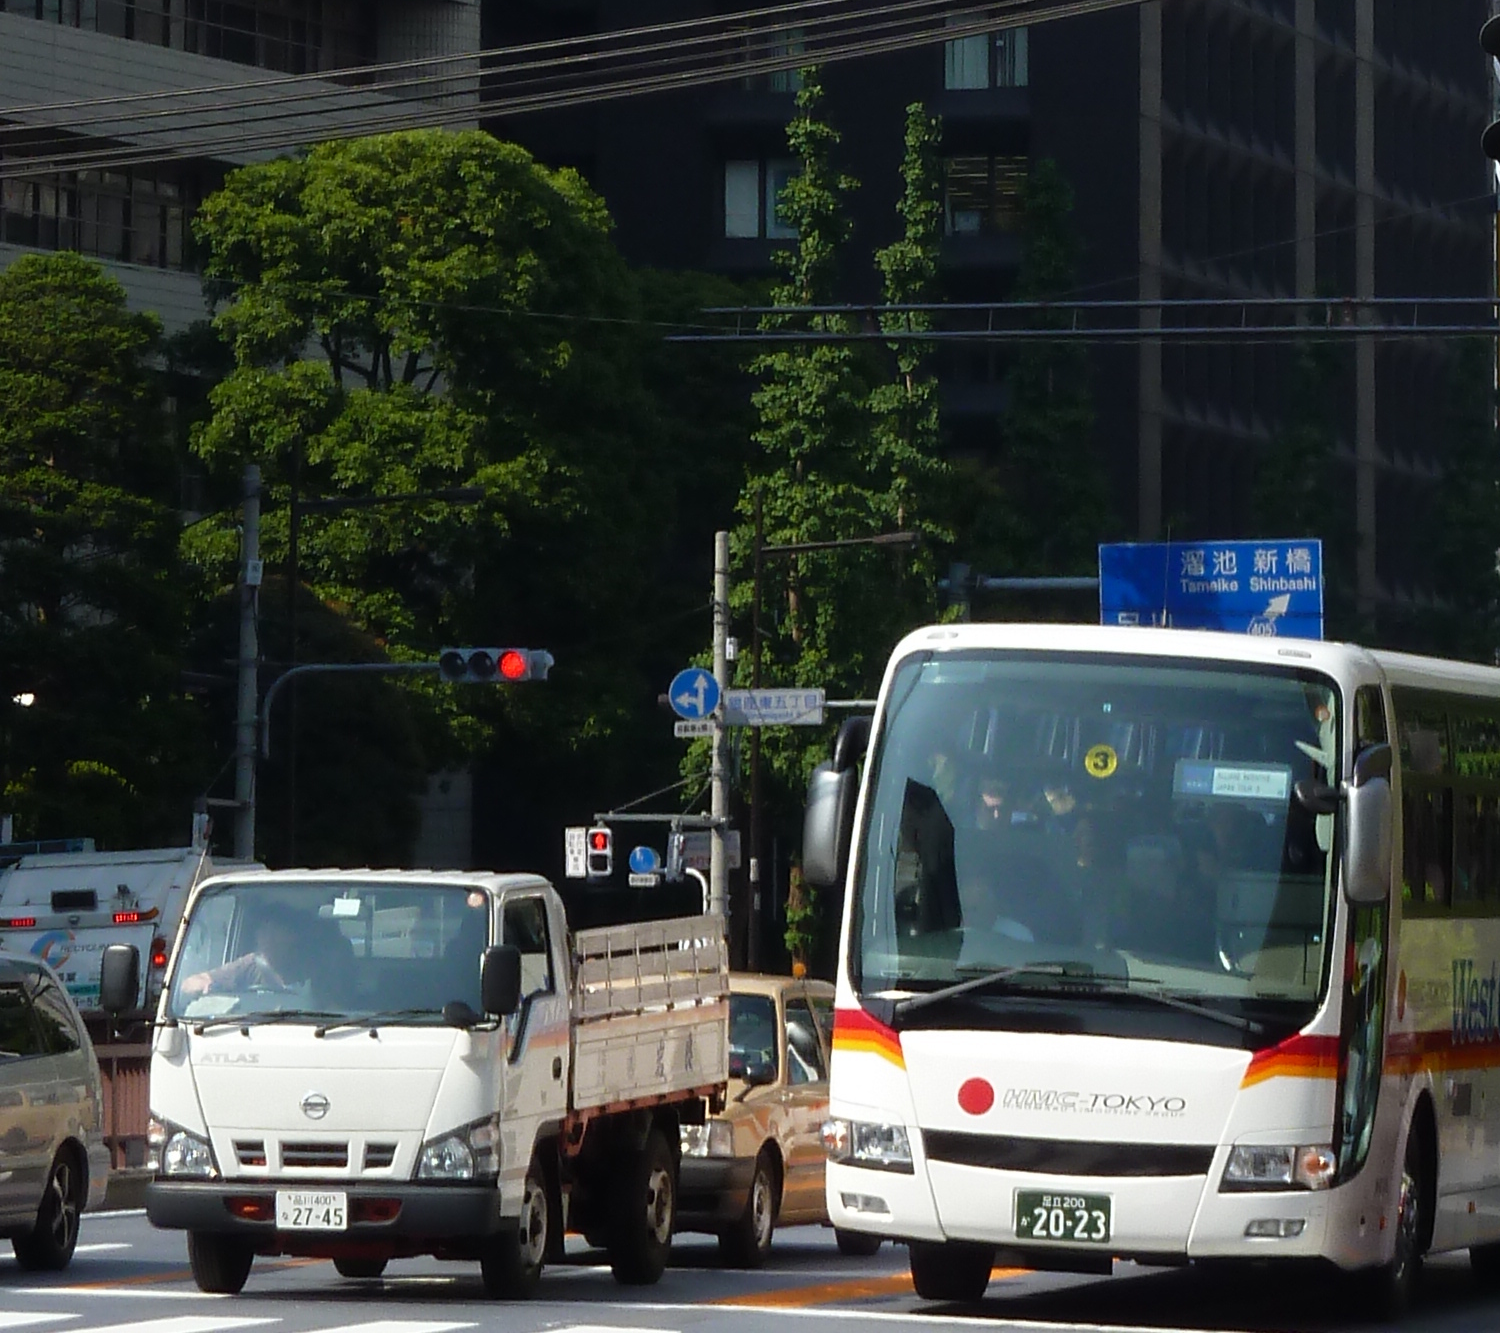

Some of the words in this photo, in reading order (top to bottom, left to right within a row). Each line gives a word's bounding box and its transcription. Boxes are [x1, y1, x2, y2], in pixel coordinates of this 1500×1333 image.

[1180, 549, 1237, 576] 溜池
[1253, 548, 1311, 575] 新橋
[1180, 578, 1239, 593] Tameike
[1249, 576, 1316, 592] Shinbashi
[1251, 622, 1273, 637] 405
[1093, 751, 1109, 771] 3
[1451, 958, 1496, 1045] West
[200, 1053, 261, 1064] ATLAS
